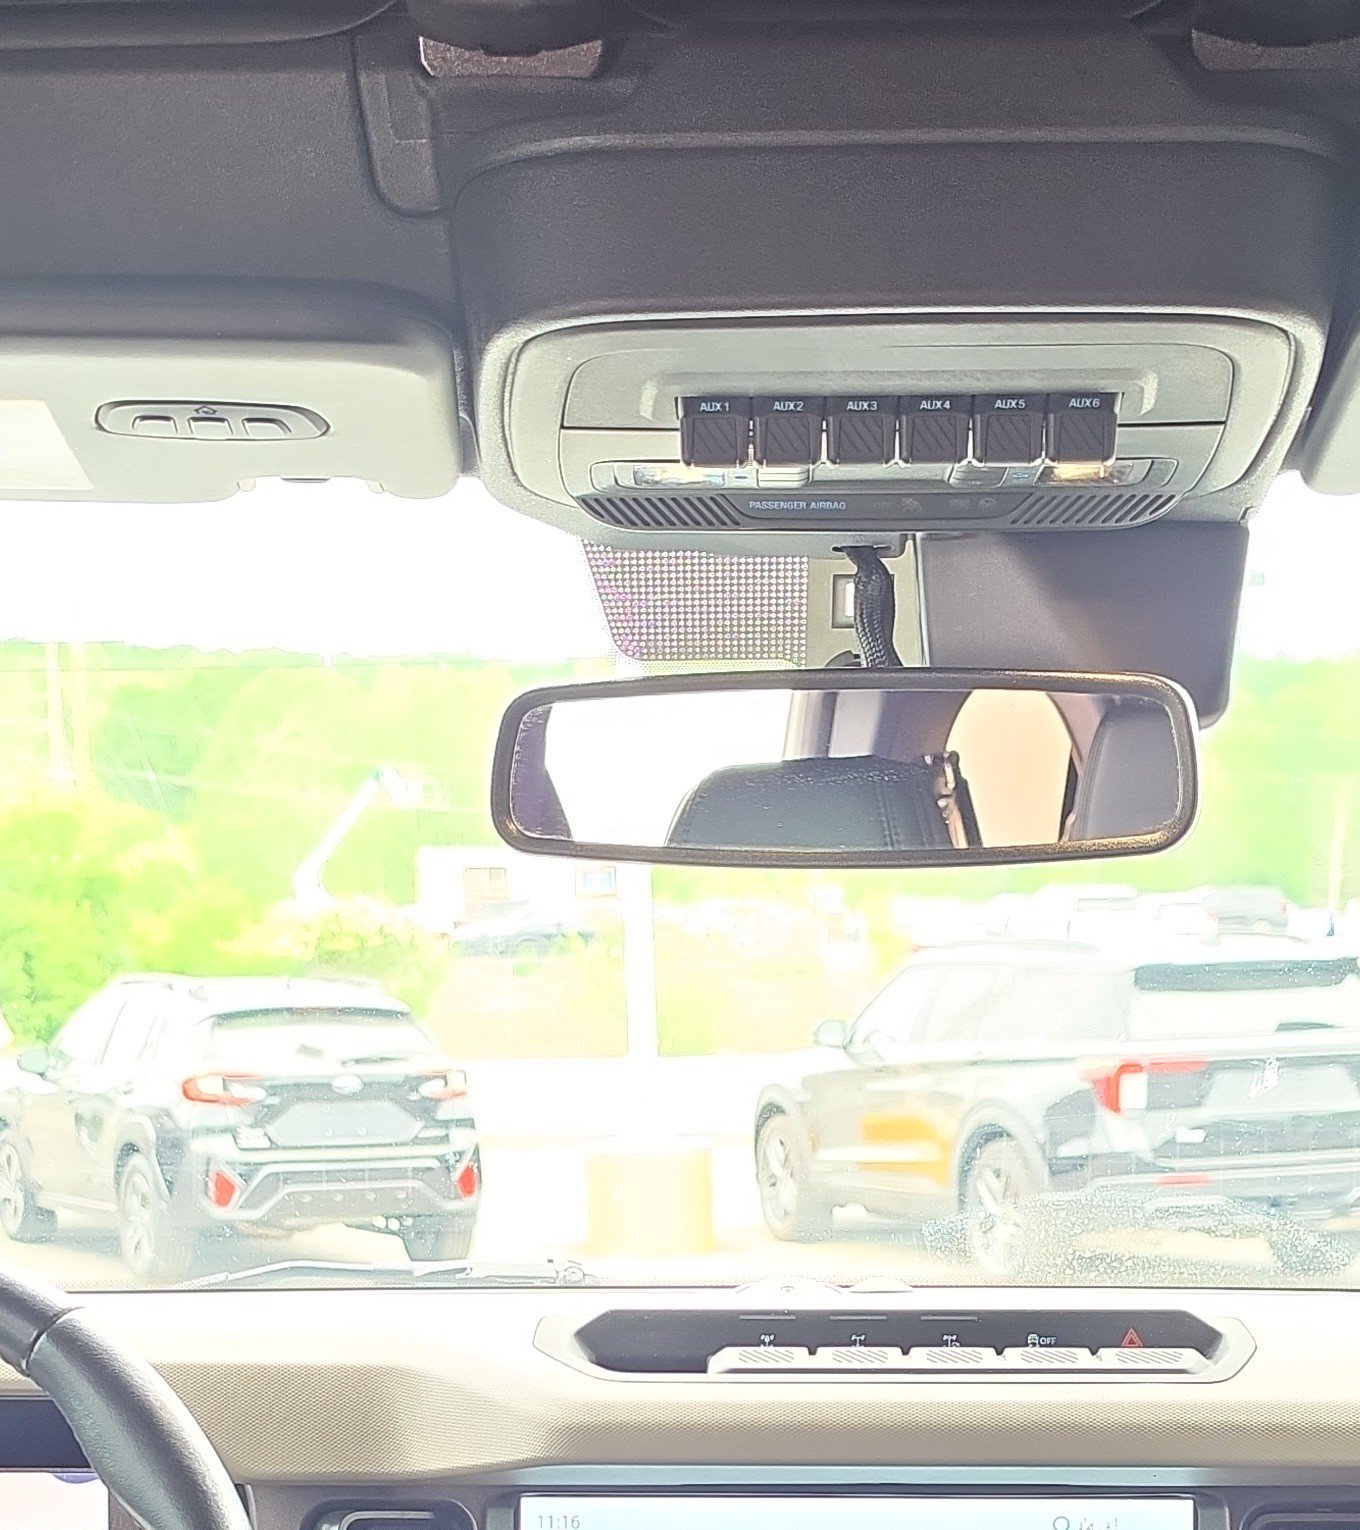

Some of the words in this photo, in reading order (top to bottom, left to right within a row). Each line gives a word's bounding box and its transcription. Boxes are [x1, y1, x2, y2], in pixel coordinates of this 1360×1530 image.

[749, 501, 807, 510] PASSENGER
[809, 501, 846, 510] AIRBAG
[1039, 1336, 1057, 1345] OFF
[537, 1514, 581, 1530] 11:16
